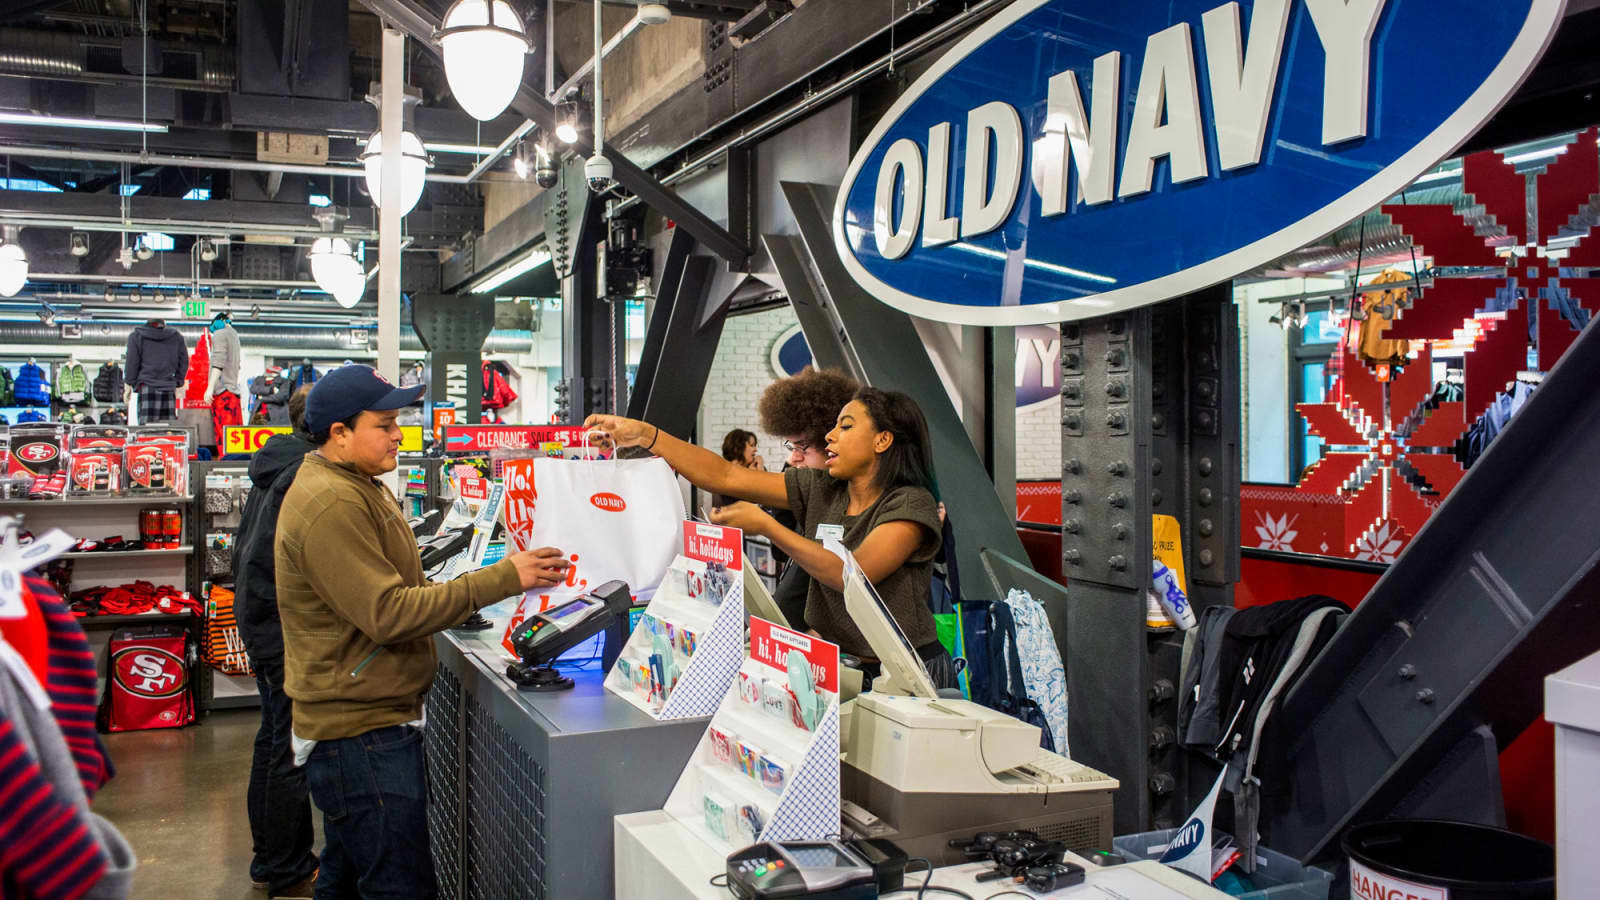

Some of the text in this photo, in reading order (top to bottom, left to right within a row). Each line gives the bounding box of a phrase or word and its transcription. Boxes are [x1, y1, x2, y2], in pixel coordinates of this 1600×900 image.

[875, 0, 1386, 260] OLD NAVY
[186, 301, 206, 316] EXIT
[477, 431, 529, 448] CLEARANCE
[531, 432, 552, 448] SALE
[554, 430, 570, 447] $5
[595, 496, 624, 510] OLD NAVY
[689, 535, 734, 566] hi, holidays
[758, 636, 772, 662] hi,
